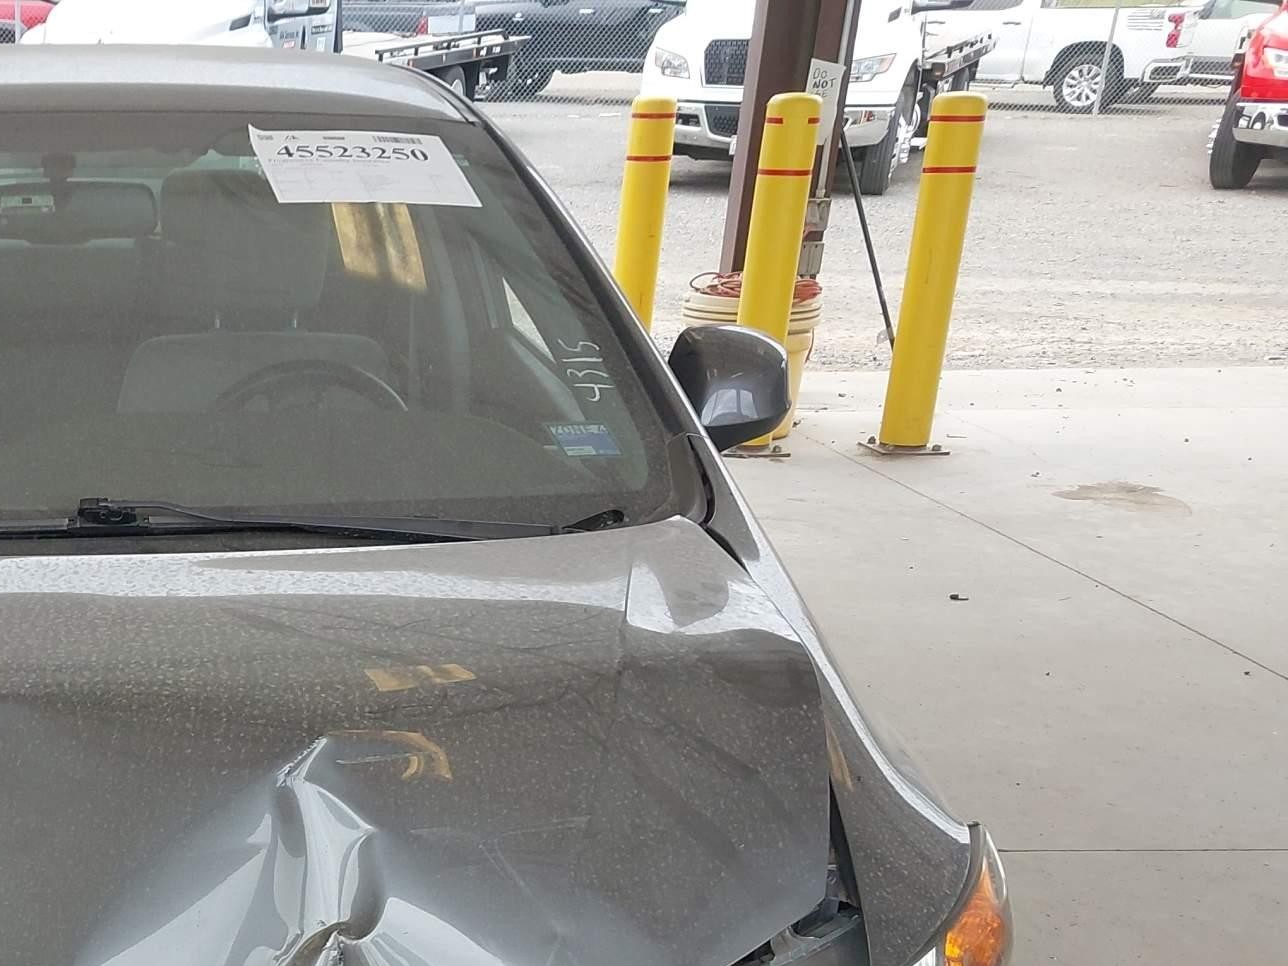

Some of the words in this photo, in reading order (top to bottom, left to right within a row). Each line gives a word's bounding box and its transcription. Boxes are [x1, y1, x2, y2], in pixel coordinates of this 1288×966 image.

[812, 78, 837, 89] NOT
[277, 145, 429, 162] 45523250
[557, 338, 616, 402] 4315
